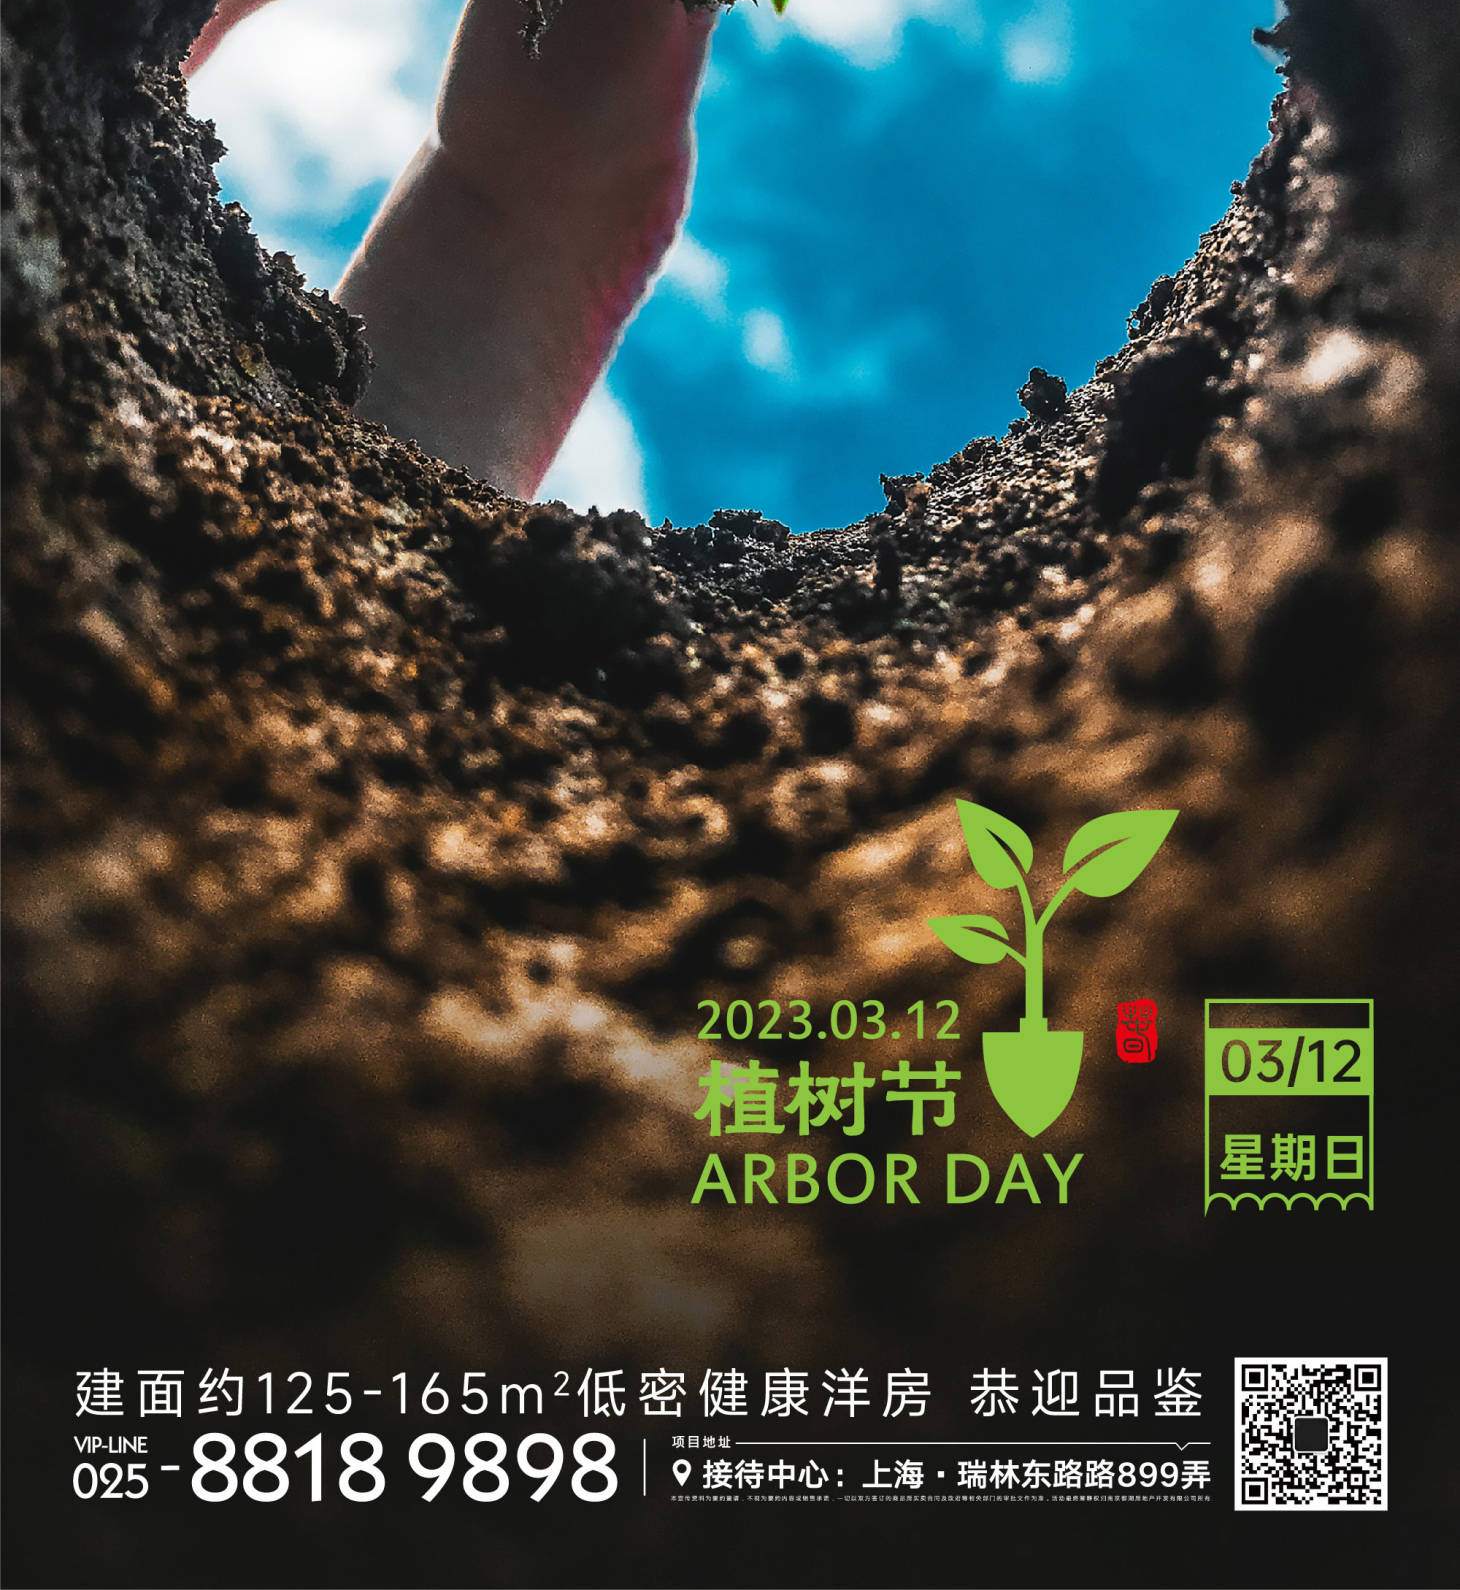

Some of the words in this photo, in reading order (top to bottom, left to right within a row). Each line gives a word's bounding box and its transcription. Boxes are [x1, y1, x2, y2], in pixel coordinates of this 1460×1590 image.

[697, 1000, 960, 1039] 2023.03.12
[1221, 1038, 1362, 1086] 03/12
[693, 1059, 962, 1137] 植树节
[691, 1153, 921, 1204] ARBOR
[947, 1153, 1084, 1204] DAY
[1220, 1132, 1364, 1181] 星期日
[971, 1366, 1202, 1418] 恭迎品鉴
[73, 1435, 148, 1453] VIP-LINE
[671, 1435, 731, 1448] 项目地址
[408, 1431, 618, 1502] 9898
